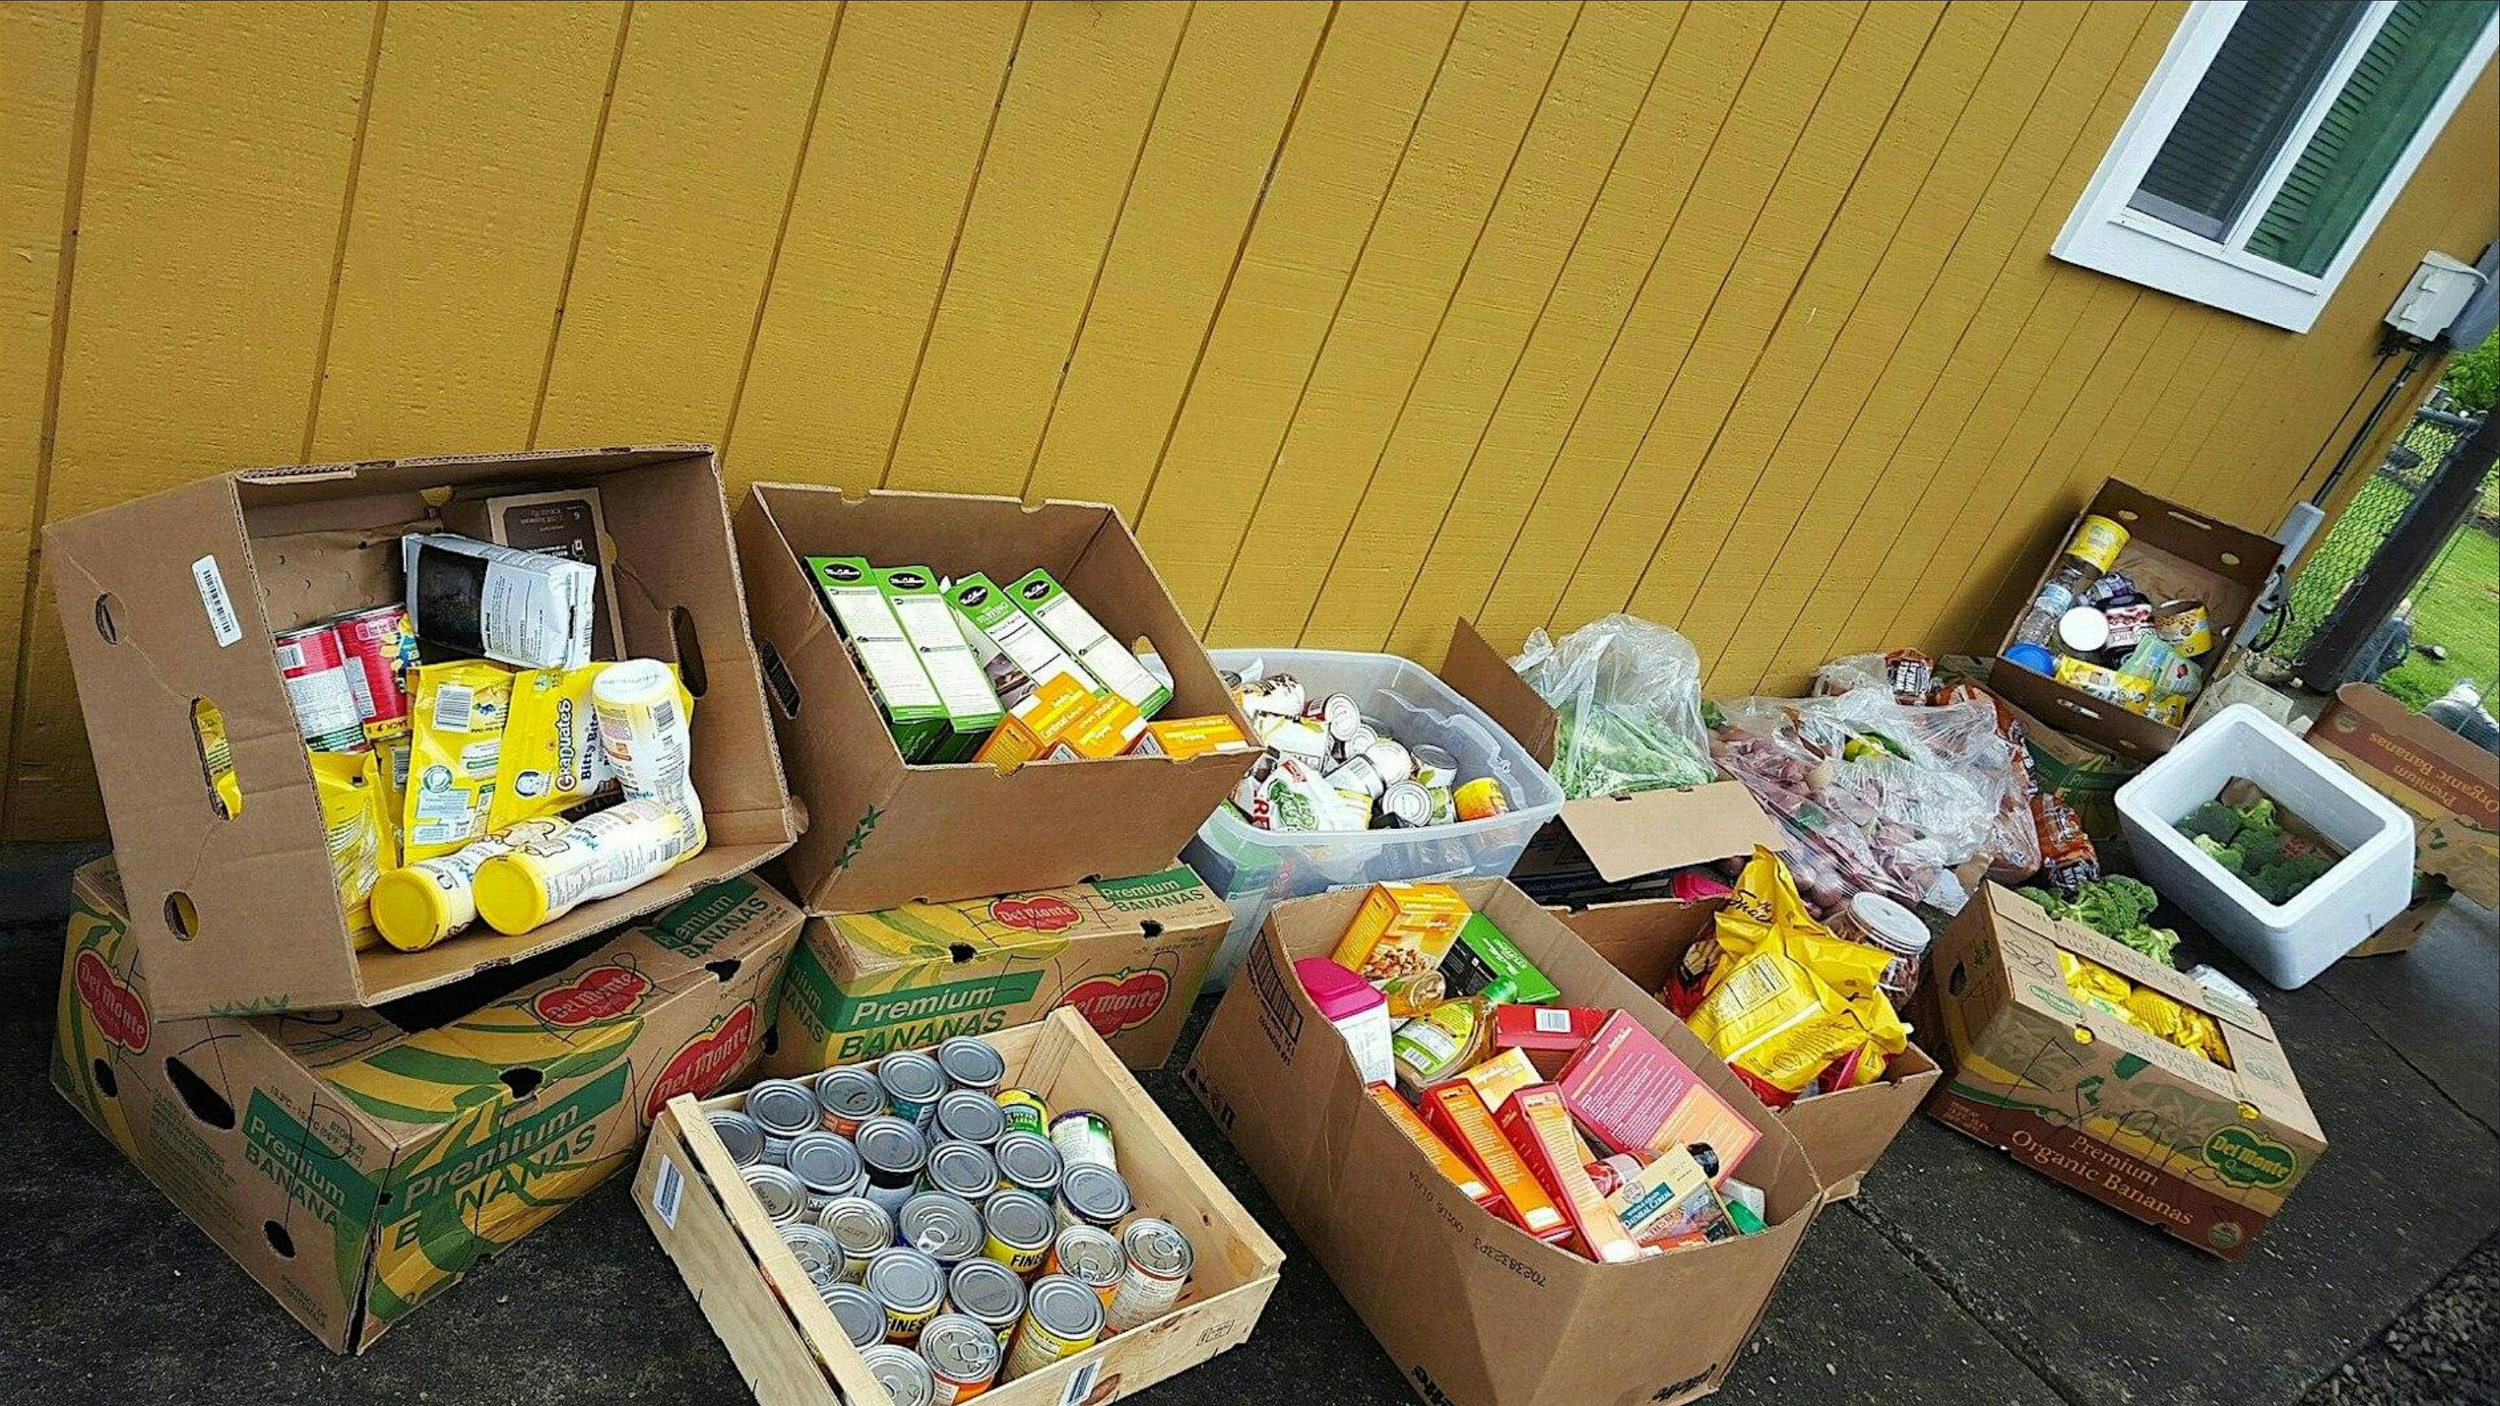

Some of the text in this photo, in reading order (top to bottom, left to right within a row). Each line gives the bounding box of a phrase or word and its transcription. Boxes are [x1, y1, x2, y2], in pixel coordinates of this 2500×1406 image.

[580, 744, 598, 780] Bitty
[2369, 732, 2499, 813] Organic Bananas
[2393, 765, 2457, 806] Premium
[1103, 878, 1180, 899] Premium
[1116, 889, 1205, 912] BANANAS
[1000, 904, 1074, 922] Del Monte
[579, 972, 635, 1009] Monte
[851, 985, 996, 1026] Premium
[1099, 991, 1162, 1014] Monte
[837, 1009, 1008, 1060] BANANAS
[250, 1115, 347, 1207] Premium
[403, 1104, 580, 1211] Premium
[2010, 1128, 2194, 1226] Organic Bananas
[2070, 1135, 2159, 1187] Premium
[2212, 1135, 2237, 1160] Del
[2236, 1142, 2290, 1179] Monte
[394, 1123, 598, 1251] BNANAS
[887, 1314, 933, 1332] INES
